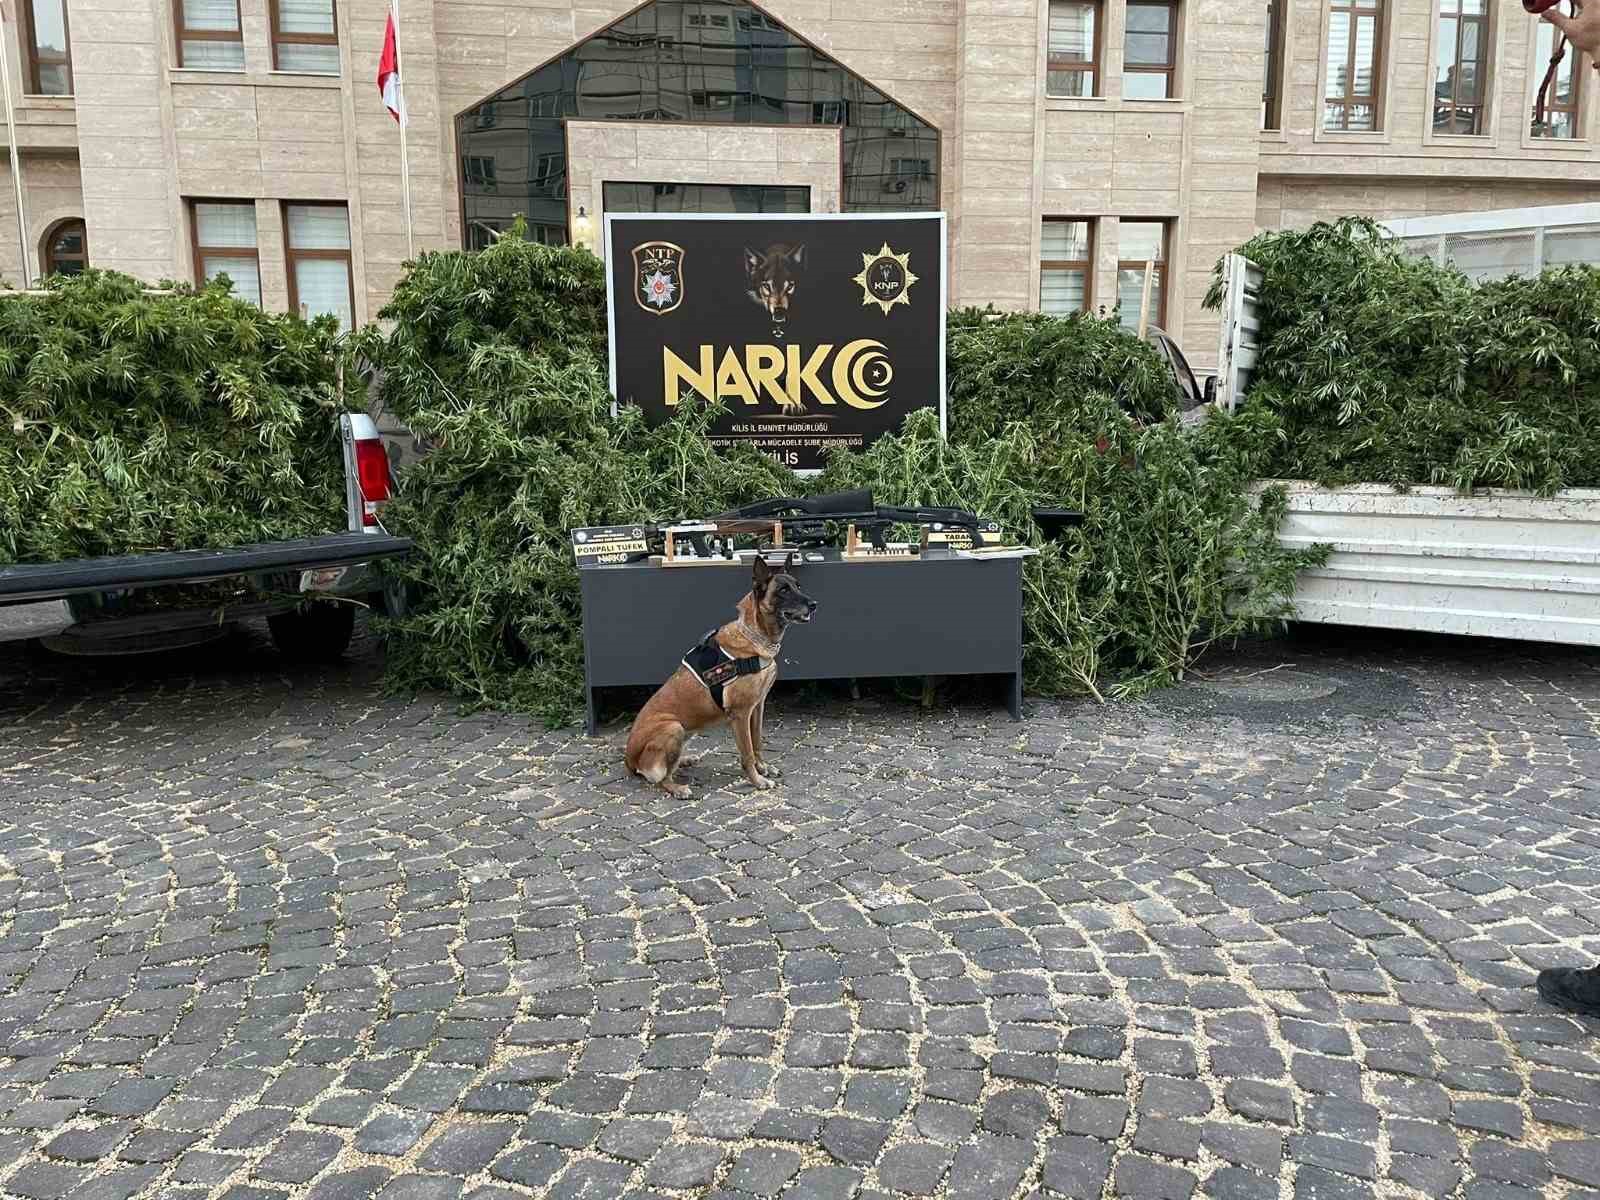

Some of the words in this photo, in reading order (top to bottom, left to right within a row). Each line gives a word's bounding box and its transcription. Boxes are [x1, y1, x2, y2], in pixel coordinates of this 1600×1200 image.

[645, 249, 675, 258] NTP
[874, 281, 899, 289] KNP
[663, 338, 893, 410] NARKO
[787, 421, 828, 432] MÜDÜRLÜĞÜ
[768, 438, 802, 447] MÜCADELE
